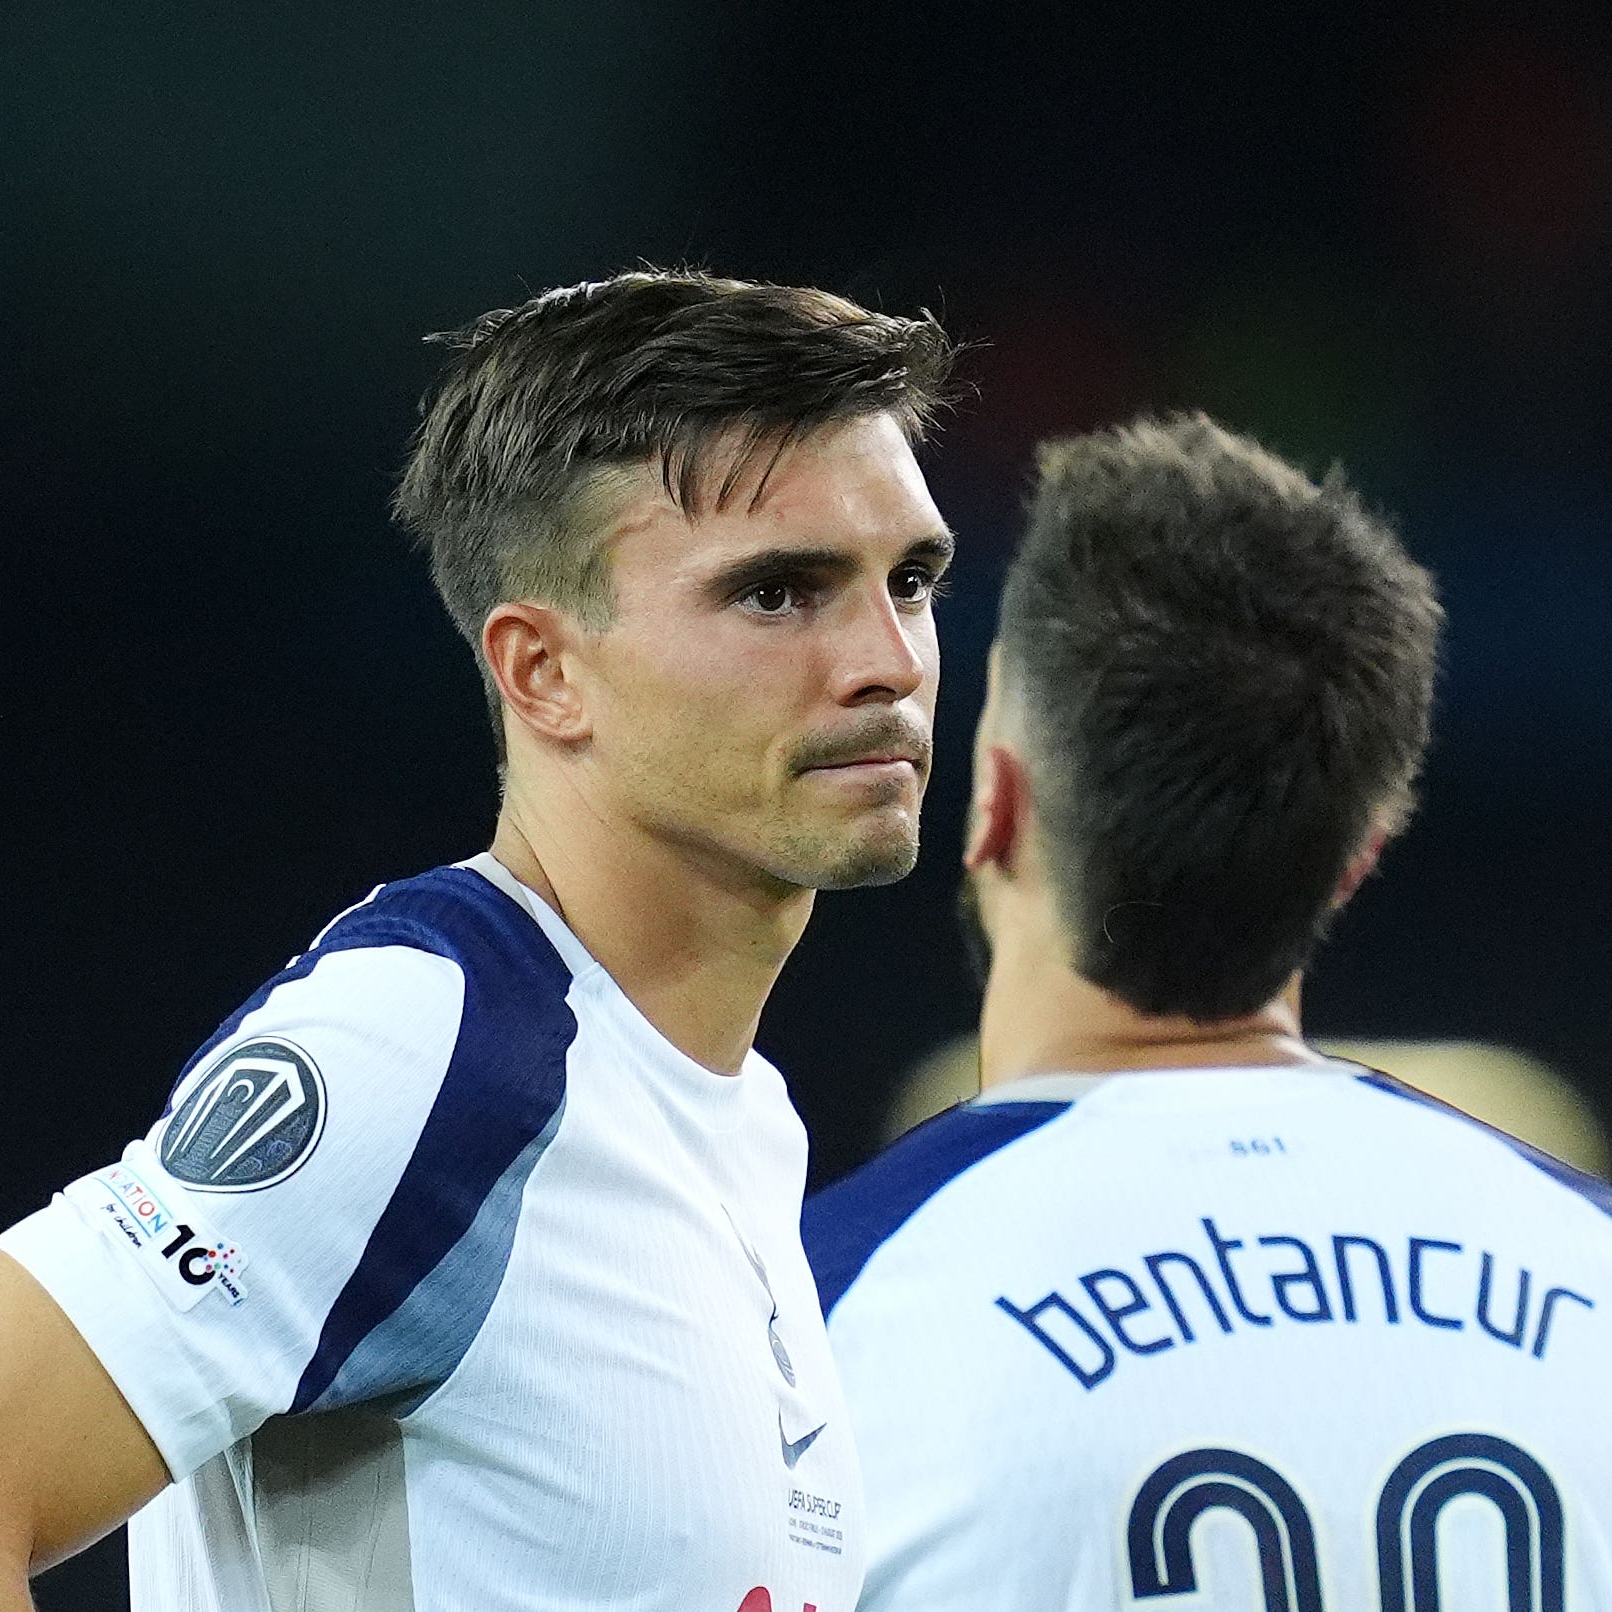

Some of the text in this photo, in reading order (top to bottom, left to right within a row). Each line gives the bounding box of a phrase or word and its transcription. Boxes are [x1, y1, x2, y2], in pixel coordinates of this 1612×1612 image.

[161, 1224, 217, 1285] 10
[218, 1272, 240, 1299] YEARS
[994, 1217, 1594, 1391] bentancur
